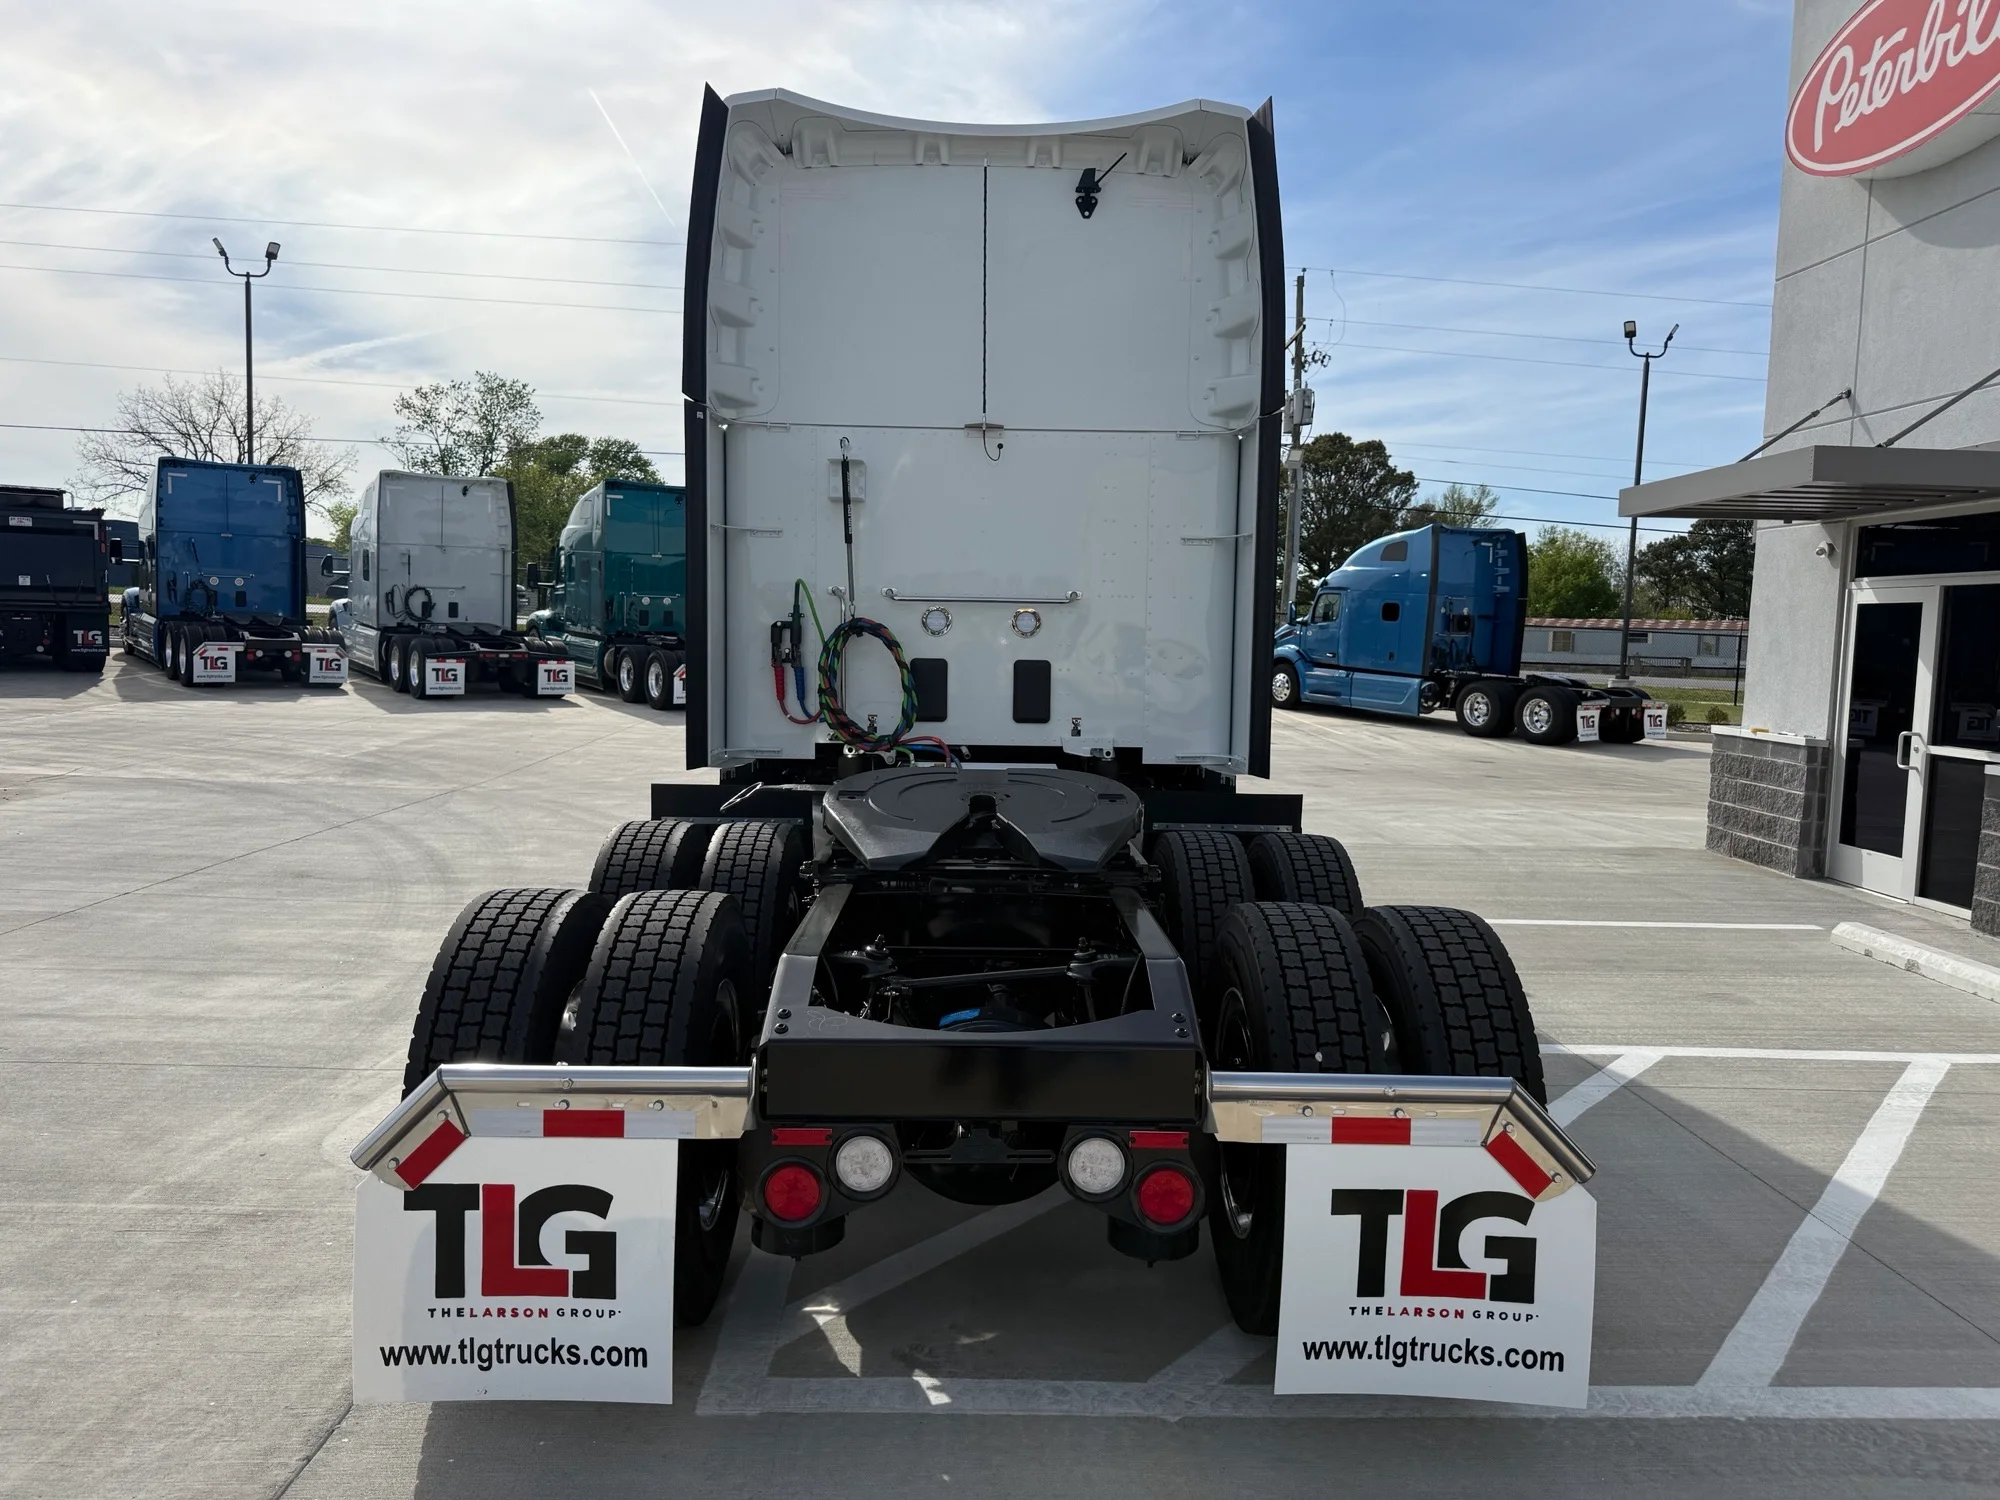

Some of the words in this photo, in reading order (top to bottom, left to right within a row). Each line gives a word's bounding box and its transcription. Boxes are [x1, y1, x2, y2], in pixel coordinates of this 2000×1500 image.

[1813, 0, 2000, 153] Peterbil
[73, 630, 102, 645] TLG
[199, 656, 228, 670] TLG
[316, 658, 342, 671] TLG
[431, 668, 458, 682] TLG
[543, 669, 569, 683] TLG
[1580, 715, 1595, 729] TLG
[1647, 715, 1663, 728] TLG
[403, 1183, 617, 1300] TLG
[1331, 1189, 1537, 1304] TLG
[556, 1307, 622, 1319] GROUP
[1472, 1309, 1539, 1323] GROUP
[379, 1337, 648, 1372] www.tlgtrucks.com
[1302, 1334, 1565, 1373] www.tlgtrucks.com
